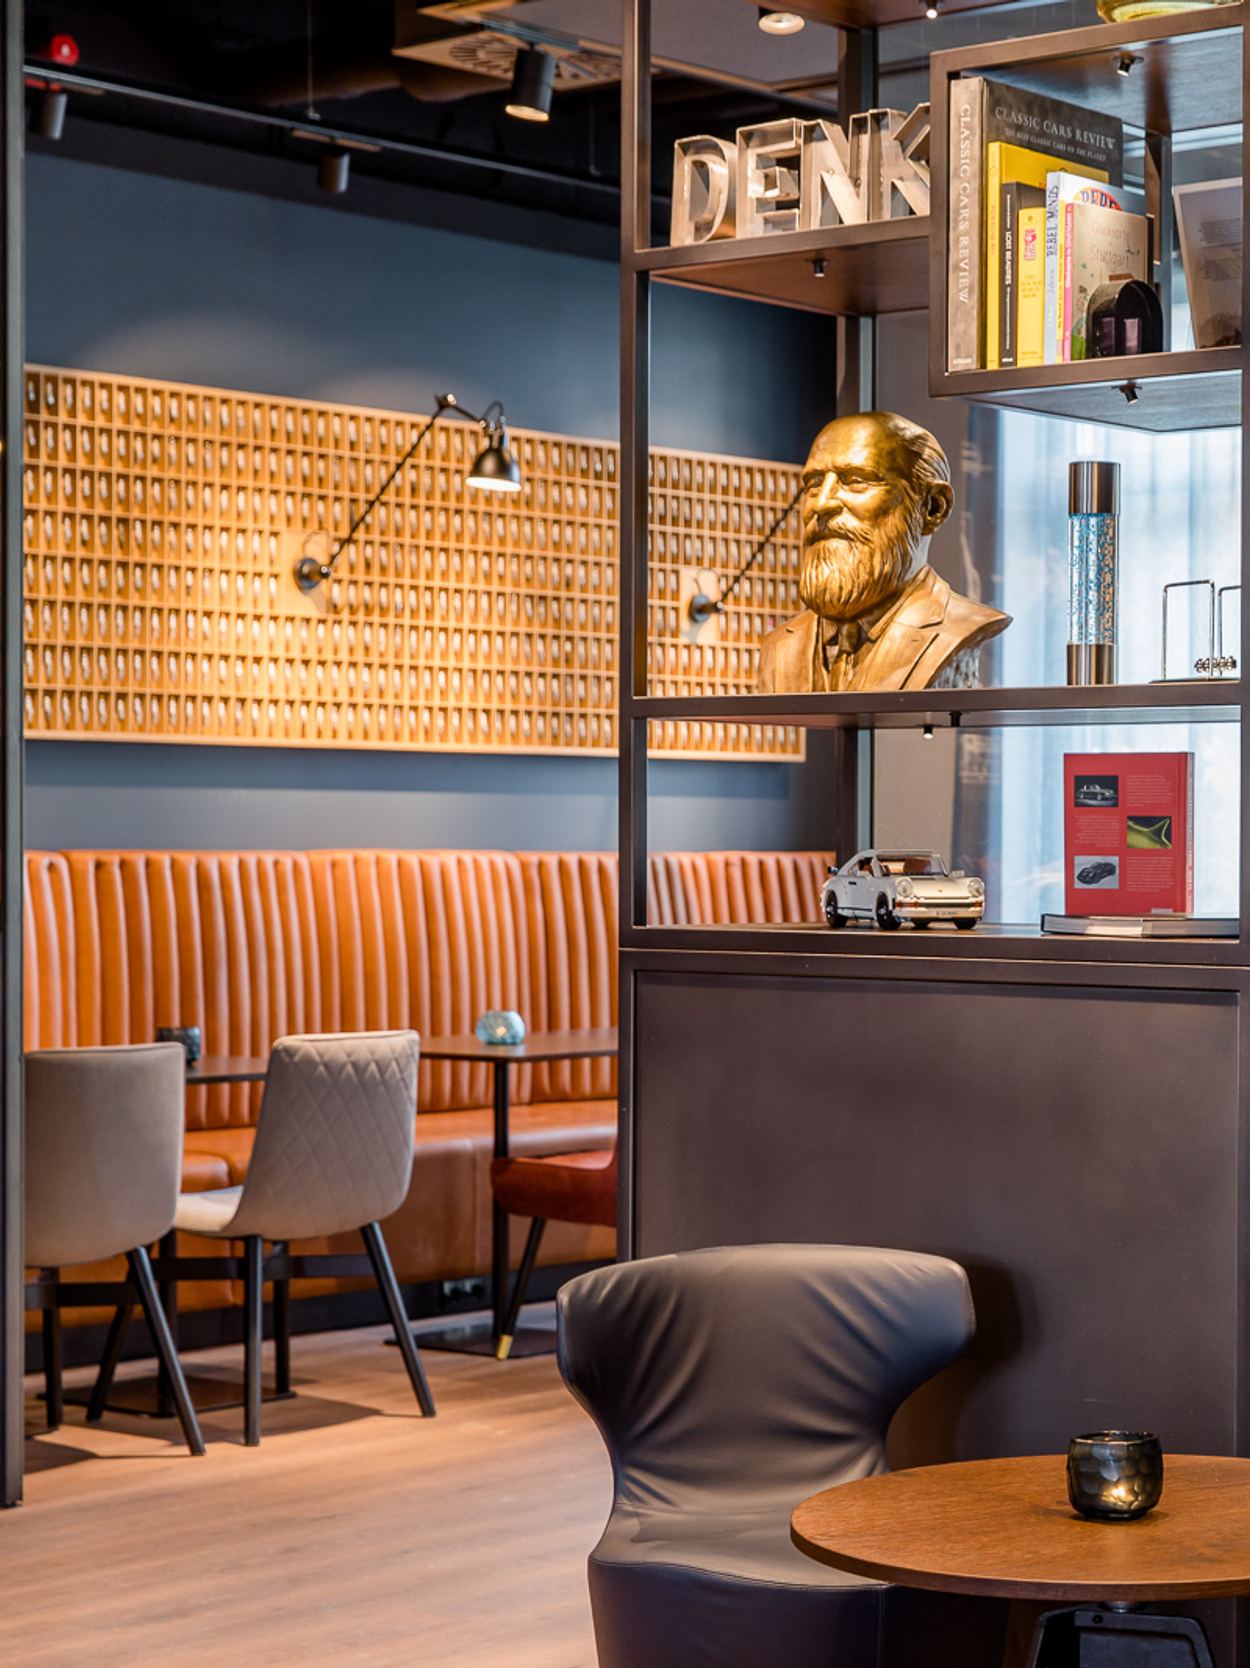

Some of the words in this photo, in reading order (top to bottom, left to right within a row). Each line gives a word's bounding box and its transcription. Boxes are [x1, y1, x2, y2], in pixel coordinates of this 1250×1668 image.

[960, 103, 971, 177] CLASSIC
[995, 106, 1040, 130] CLASSIC
[1043, 120, 1072, 138] CARS
[1076, 129, 1116, 150] REVIEW
[670, 102, 930, 247] DENK
[959, 182, 970, 230] CARS
[1047, 186, 1059, 220] MINDS
[1047, 224, 1058, 257] REBEL
[958, 235, 969, 304] REVIEW
[1004, 250, 1012, 285] BEAUTIES
